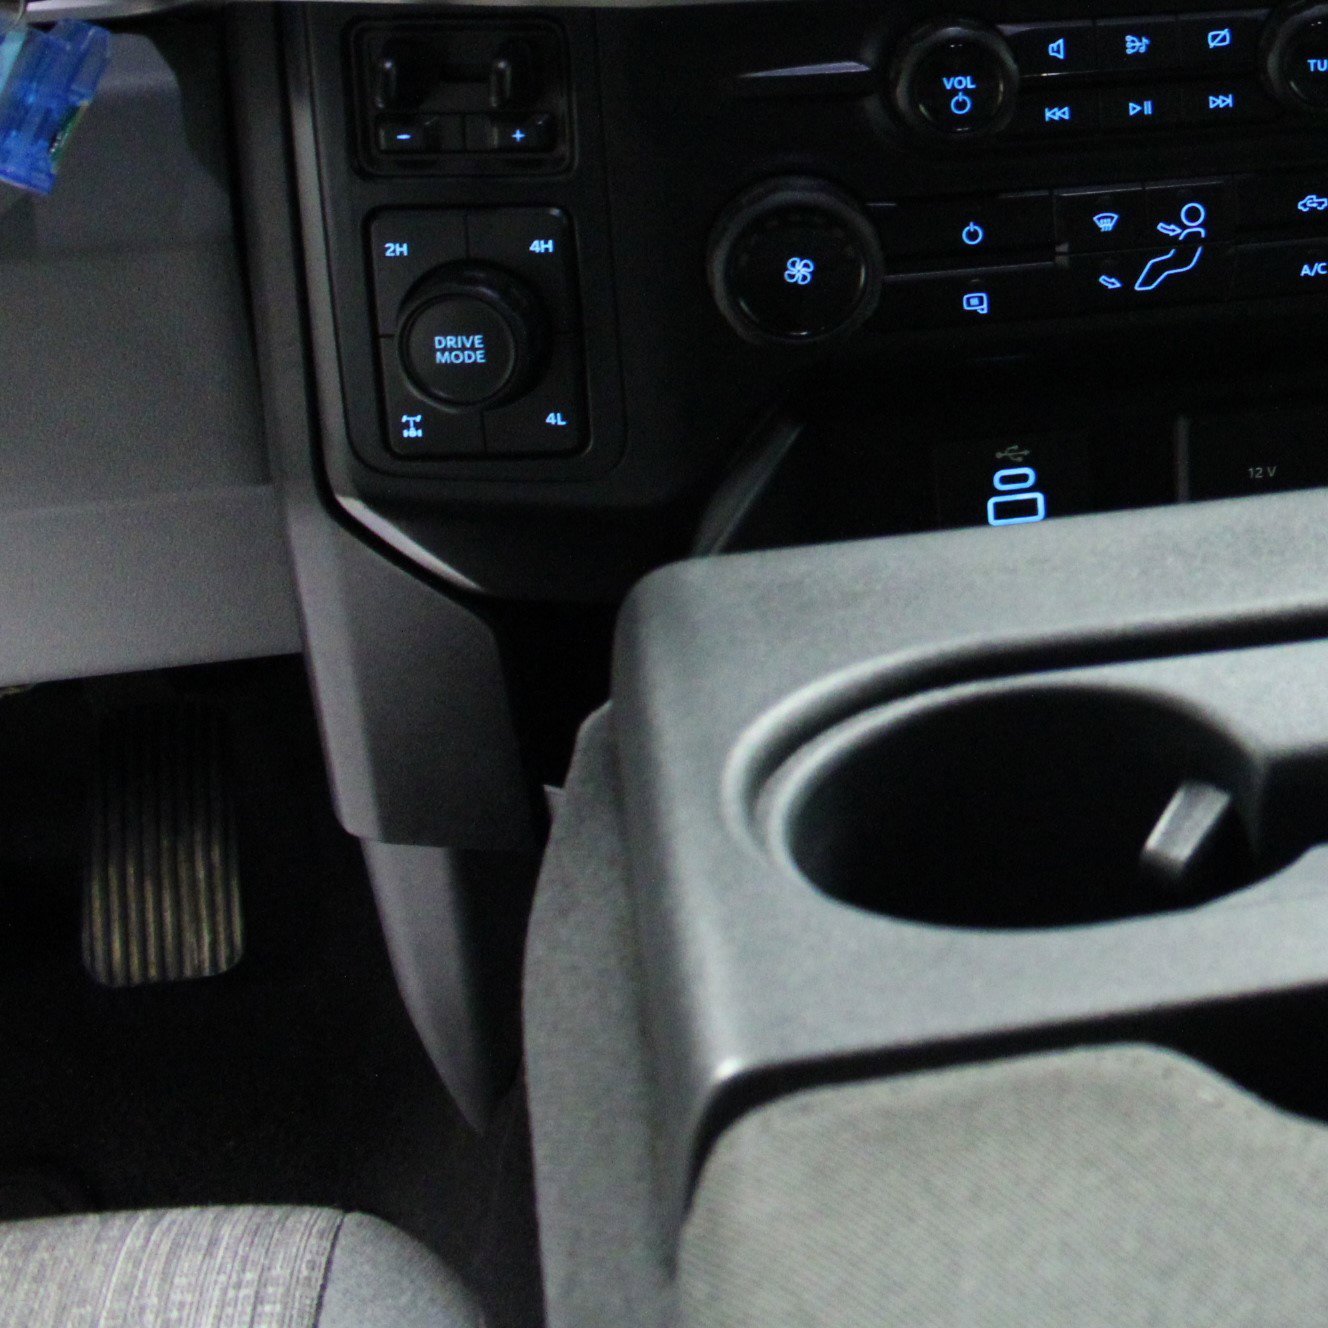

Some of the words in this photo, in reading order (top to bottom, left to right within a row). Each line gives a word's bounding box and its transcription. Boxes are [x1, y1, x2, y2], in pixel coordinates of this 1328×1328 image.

[942, 75, 976, 90] VOL
[384, 242, 409, 257] 2H
[529, 239, 555, 254] 4H
[1299, 262, 1328, 277] A/C
[434, 334, 485, 349] DRIVE
[435, 350, 486, 364] MODE
[545, 412, 567, 426] 4L
[1248, 467, 1264, 479] 12
[1266, 465, 1277, 477] V
